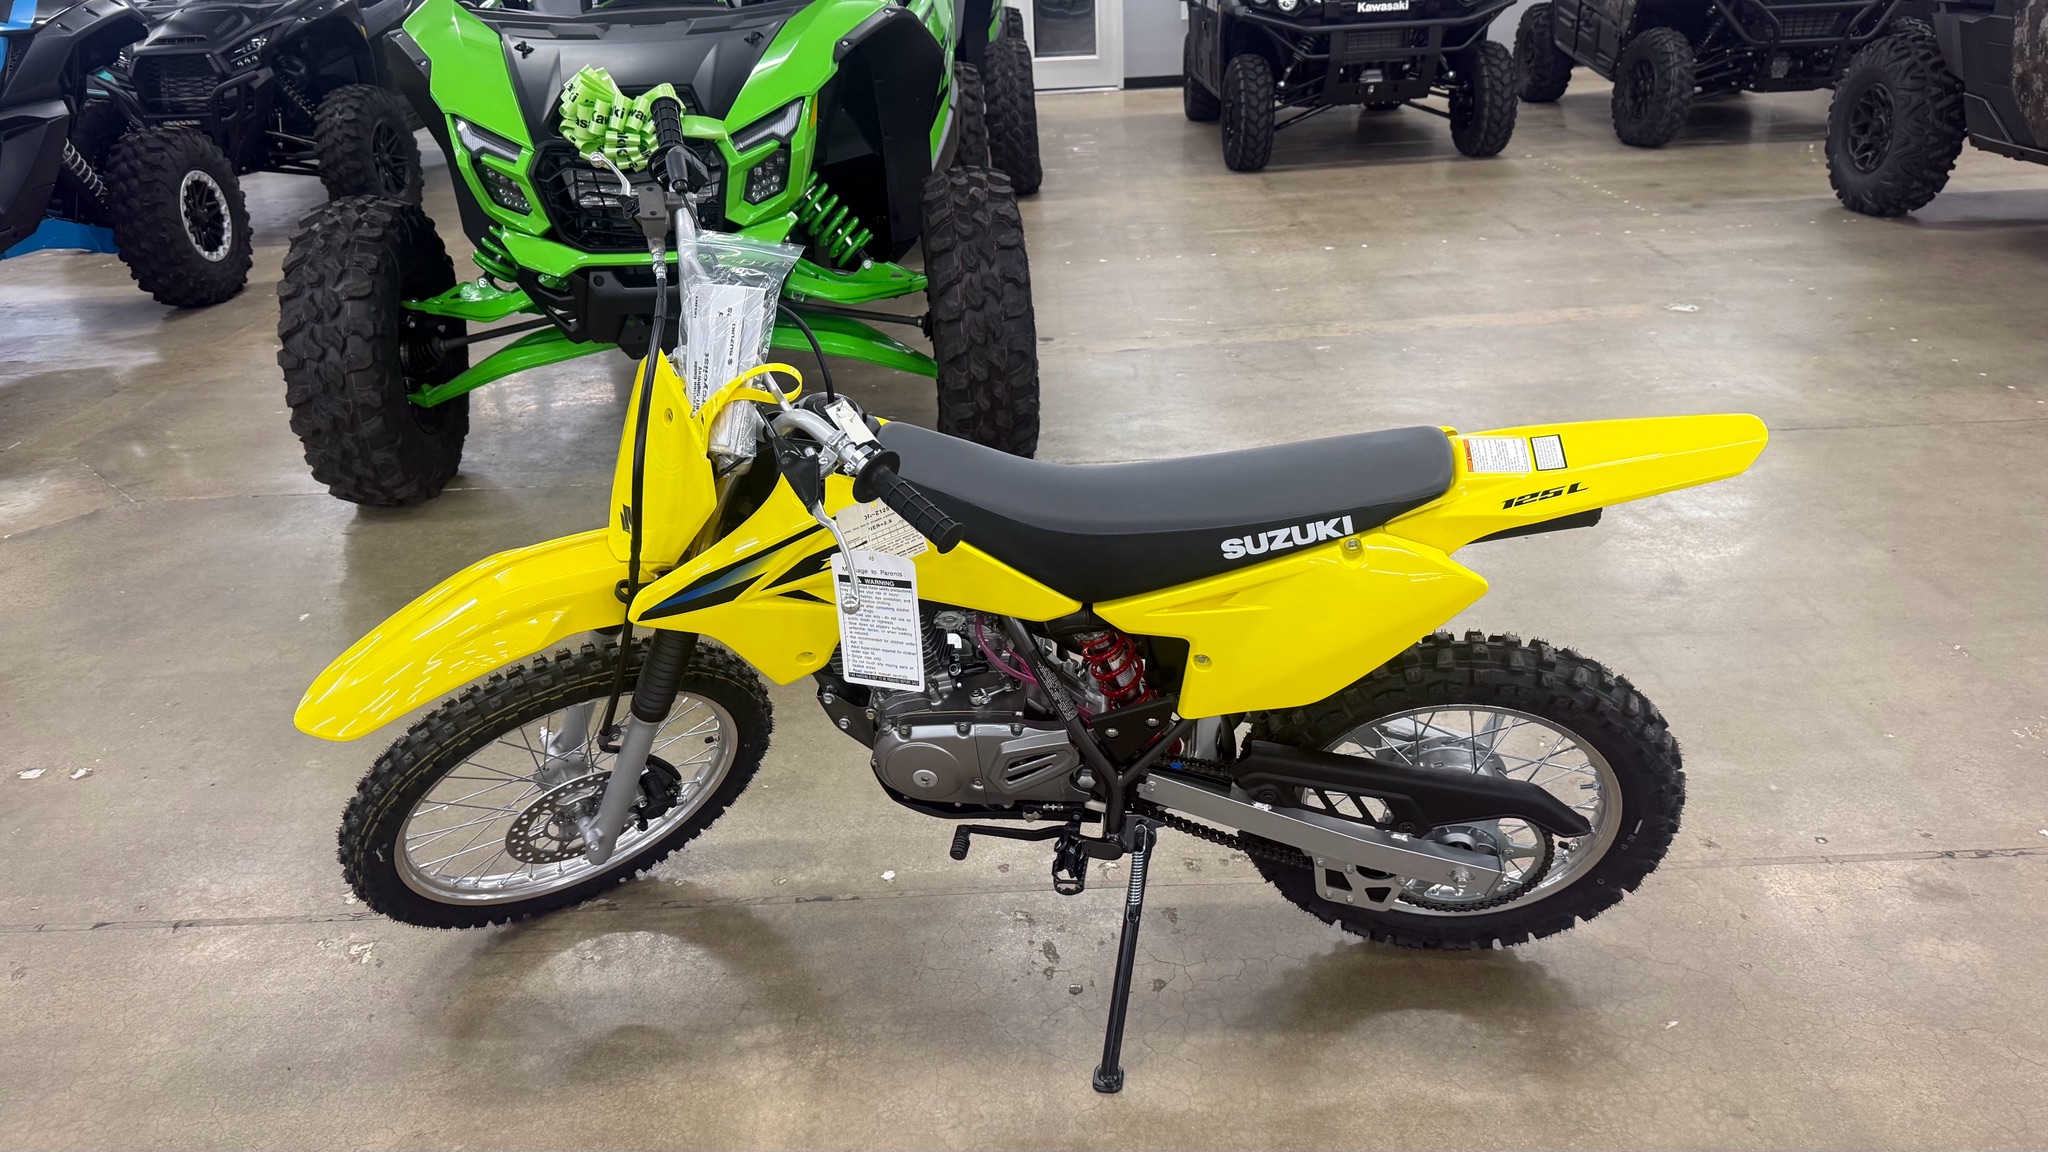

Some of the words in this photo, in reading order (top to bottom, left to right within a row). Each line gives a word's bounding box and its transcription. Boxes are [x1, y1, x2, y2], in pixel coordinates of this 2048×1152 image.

[1357, 0, 1409, 13] Kawasaki
[702, 352, 710, 404] rcyclist
[1220, 514, 1354, 560] SUZUKI
[865, 578, 895, 587] WARNING
